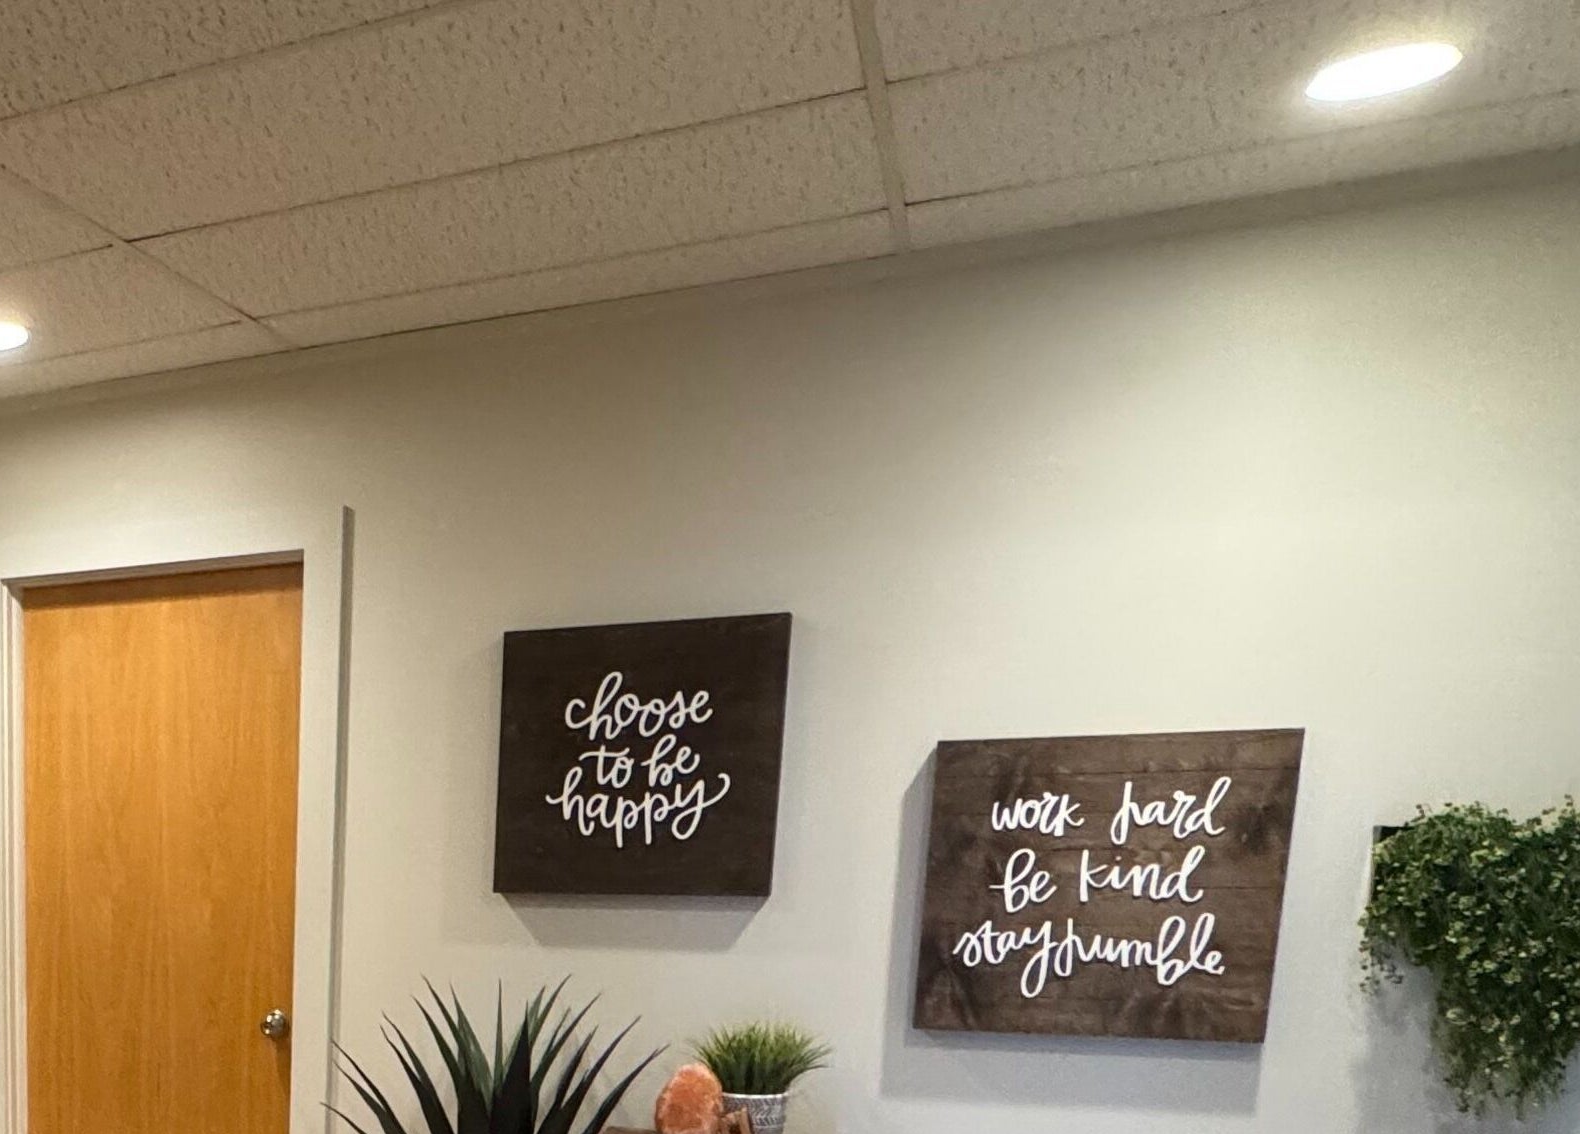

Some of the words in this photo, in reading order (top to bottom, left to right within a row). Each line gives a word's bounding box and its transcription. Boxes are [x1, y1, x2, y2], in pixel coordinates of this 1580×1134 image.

[564, 671, 713, 741] choose
[578, 744, 635, 789] to
[640, 733, 701, 787] be
[544, 766, 731, 848] happy
[991, 791, 1085, 837] work
[1110, 776, 1232, 845] hard
[989, 848, 1057, 913] be
[1079, 844, 1206, 903] kind
[952, 920, 1059, 998] stay
[1053, 912, 1226, 986] humble
